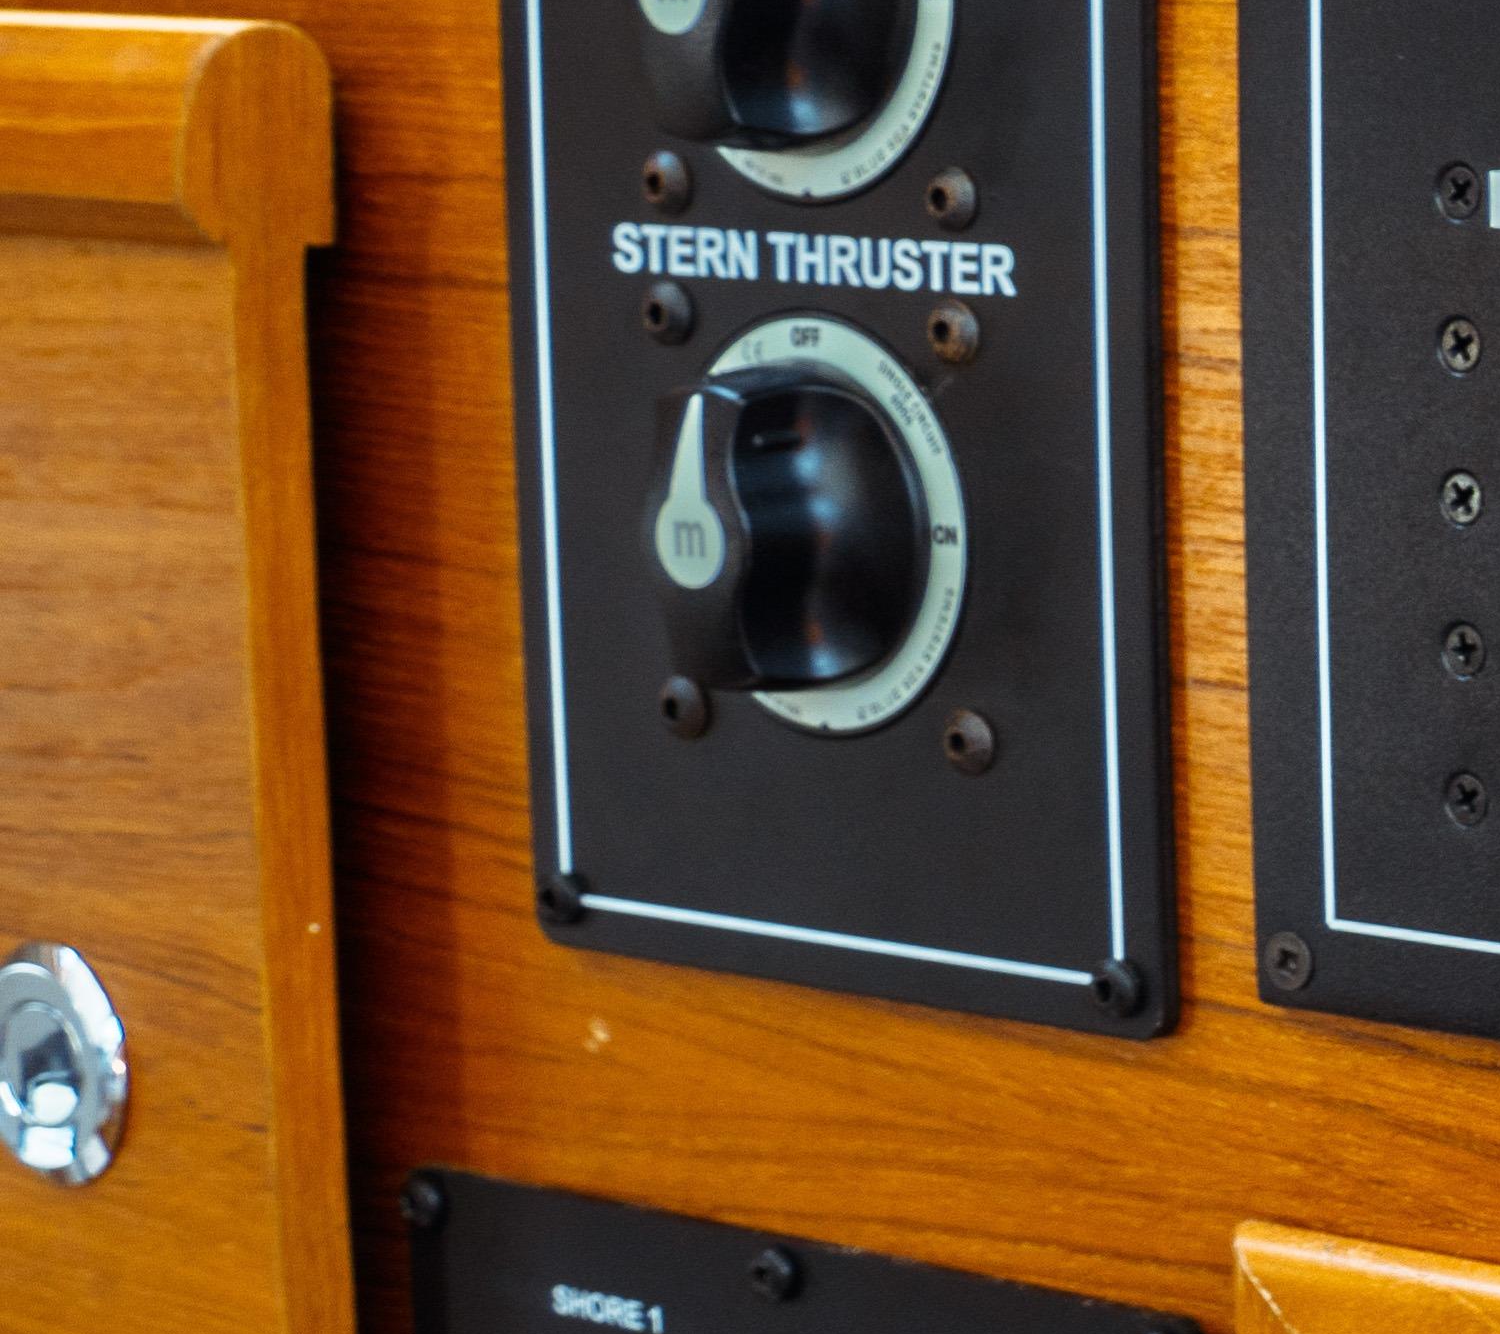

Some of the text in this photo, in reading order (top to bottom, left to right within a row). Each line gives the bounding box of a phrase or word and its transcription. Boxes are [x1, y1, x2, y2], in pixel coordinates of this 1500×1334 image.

[612, 221, 1016, 297] STERN THRUSTER
[790, 327, 820, 347] OFF
[551, 1283, 646, 1333] SHORE
